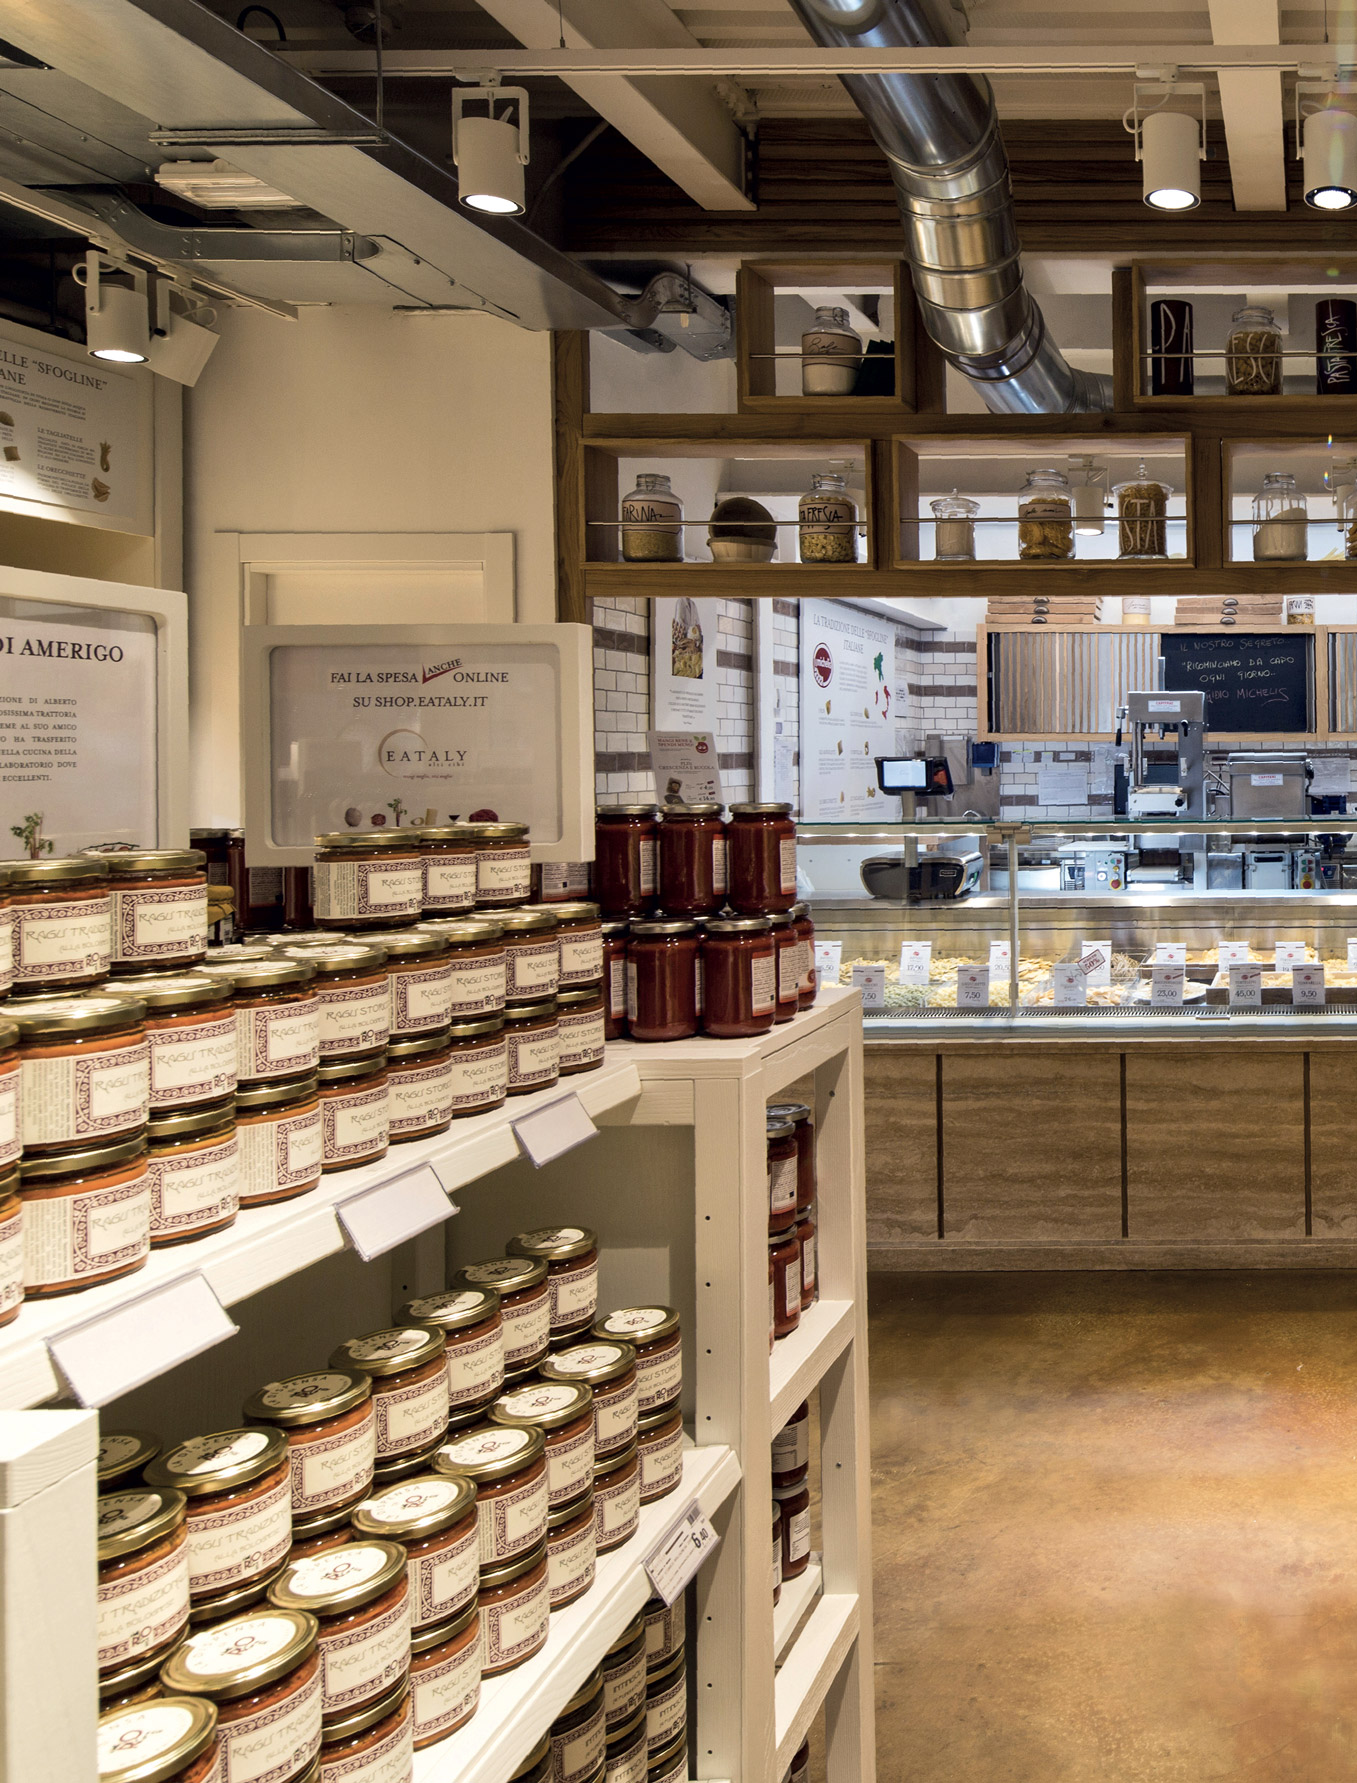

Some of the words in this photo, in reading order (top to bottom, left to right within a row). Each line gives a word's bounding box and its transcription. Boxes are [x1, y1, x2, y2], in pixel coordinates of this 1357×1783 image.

[19, 639, 124, 662] AMERIGO
[1194, 640, 1234, 651] NOSTRO
[330, 672, 352, 683] FAI
[355, 672, 374, 683] LA
[377, 672, 419, 683] SPESA
[427, 658, 463, 675] ANCHE
[453, 672, 509, 683] ONLINE
[44, 698, 77, 706] ALBERTO
[352, 696, 372, 708] SU
[374, 696, 489, 708] SHOP.EATALY.IT
[386, 750, 467, 762] EATALY
[1156, 989, 1177, 998] 23,00
[1300, 989, 1317, 998] 9,50
[690, 1528, 709, 1549] 6,40
